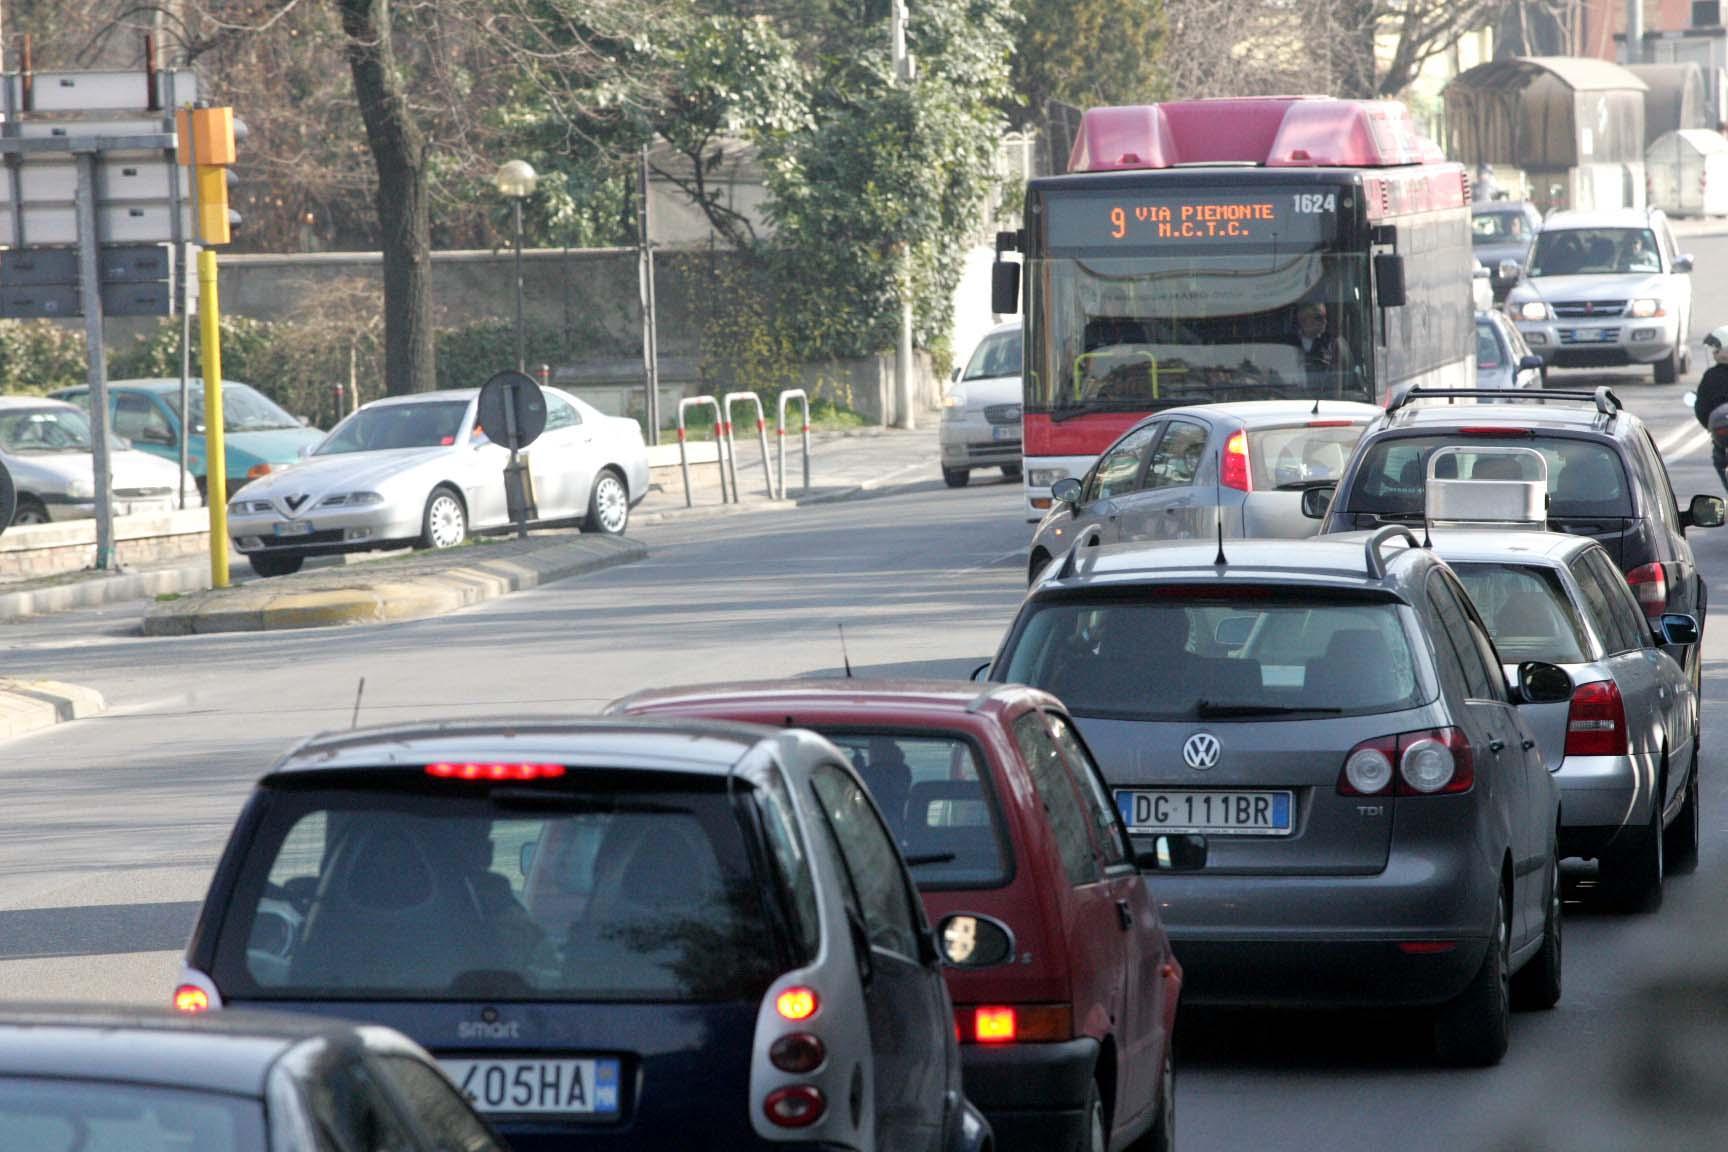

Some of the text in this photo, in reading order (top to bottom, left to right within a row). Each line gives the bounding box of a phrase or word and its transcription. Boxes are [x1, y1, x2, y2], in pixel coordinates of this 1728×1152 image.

[1293, 194, 1336, 213] 1624
[1111, 204, 1274, 238] 9 VIA PIEMONTE
[1136, 795, 1168, 823] DG
[1185, 796, 1268, 825] 111BR
[1357, 806, 1383, 816] TDI
[458, 1022, 519, 1038] smart
